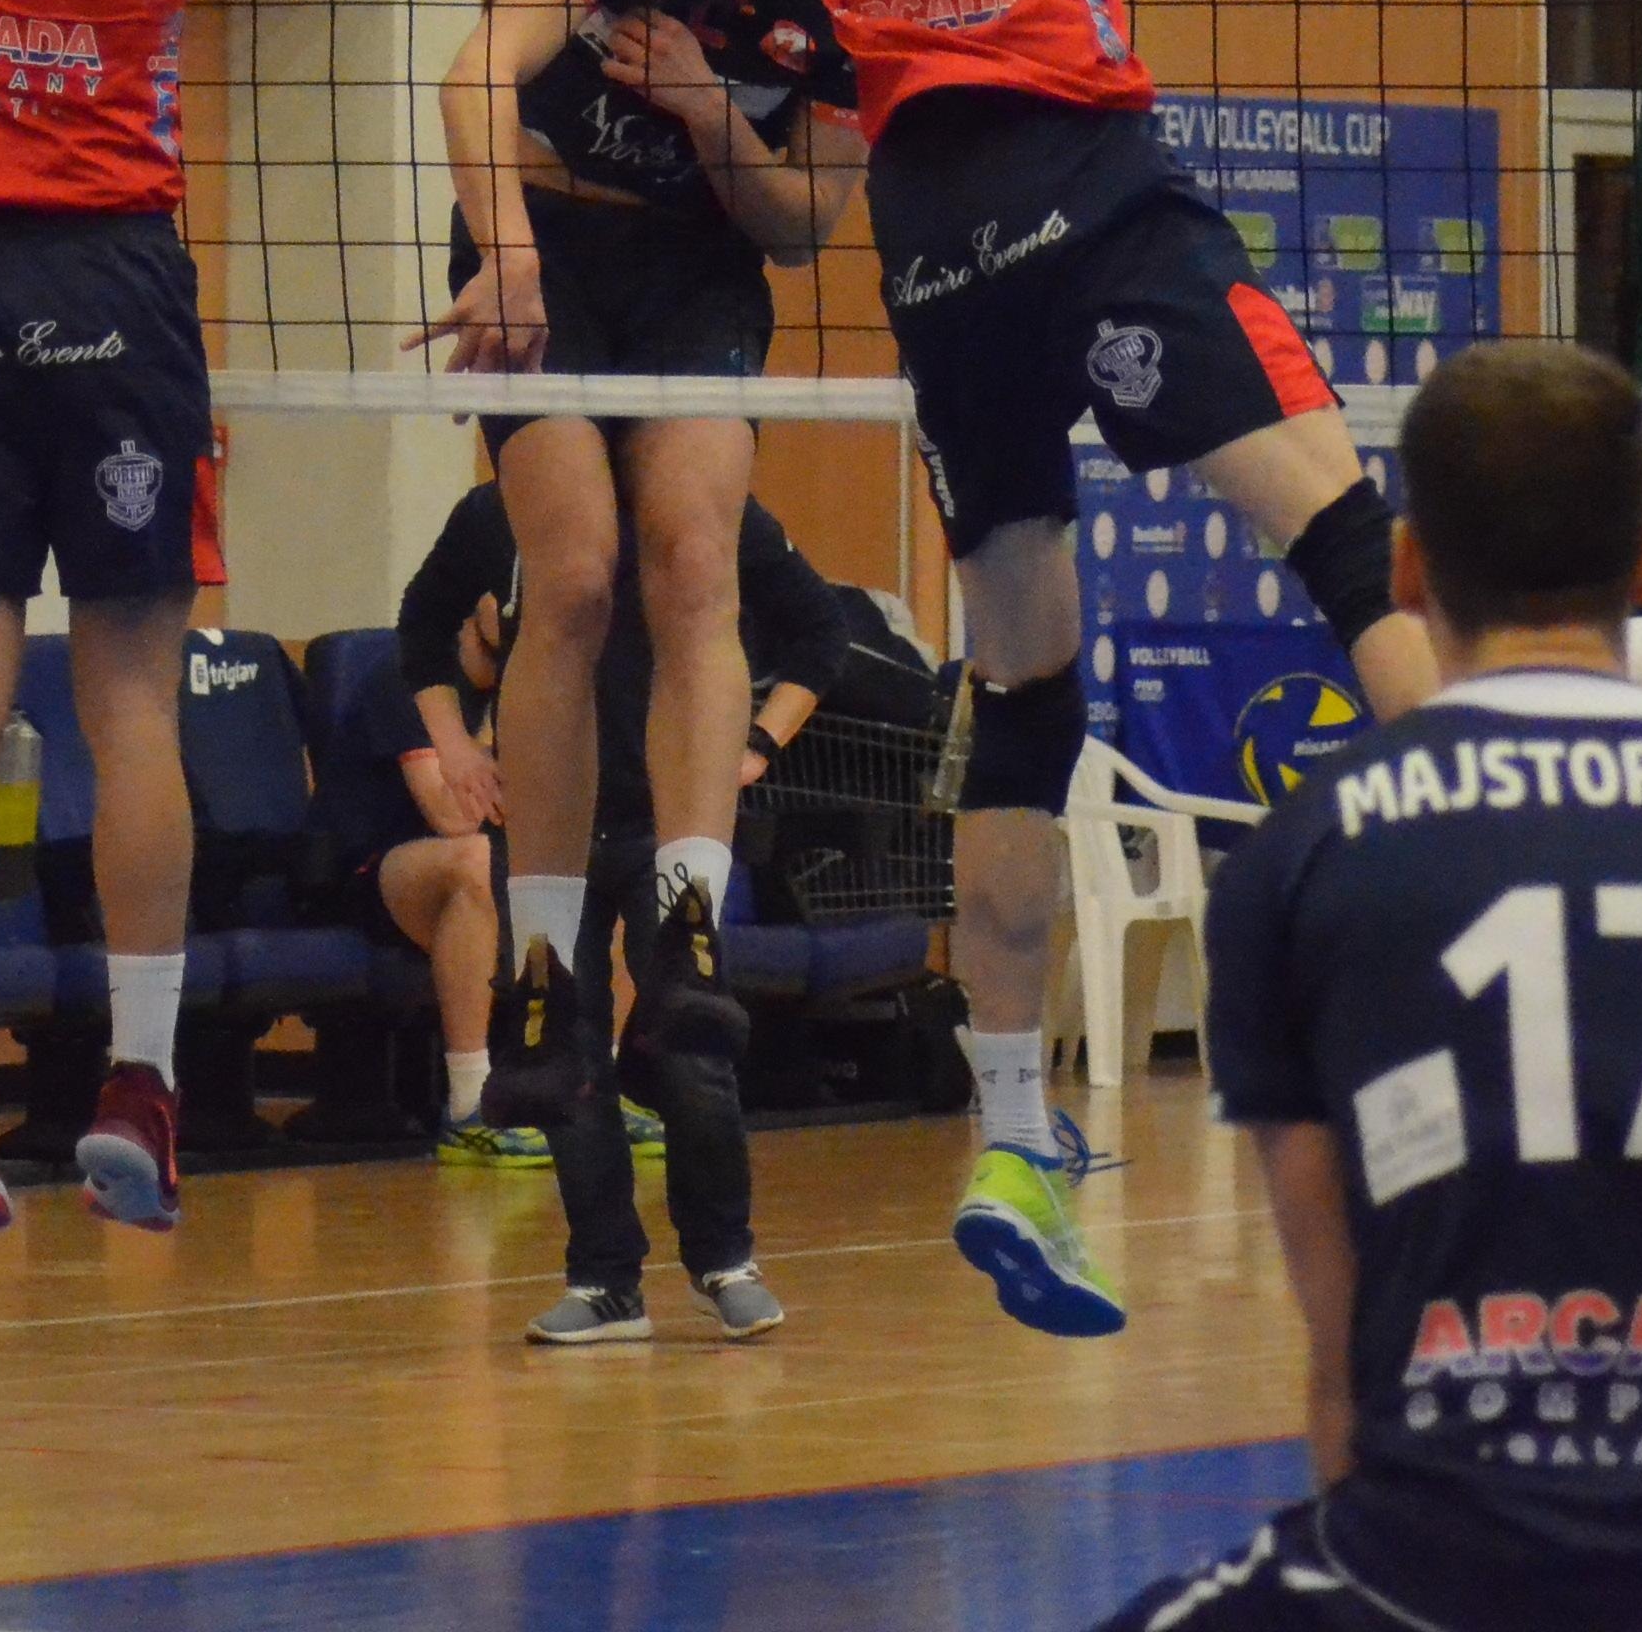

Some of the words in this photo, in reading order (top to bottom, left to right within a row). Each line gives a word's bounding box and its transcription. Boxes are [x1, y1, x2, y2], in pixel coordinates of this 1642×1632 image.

[1201, 106, 1341, 156] VOLLEYBALL
[1345, 113, 1390, 158] CUP
[892, 254, 973, 307] Amiro
[972, 209, 1072, 276] Events
[16, 319, 126, 366] Events
